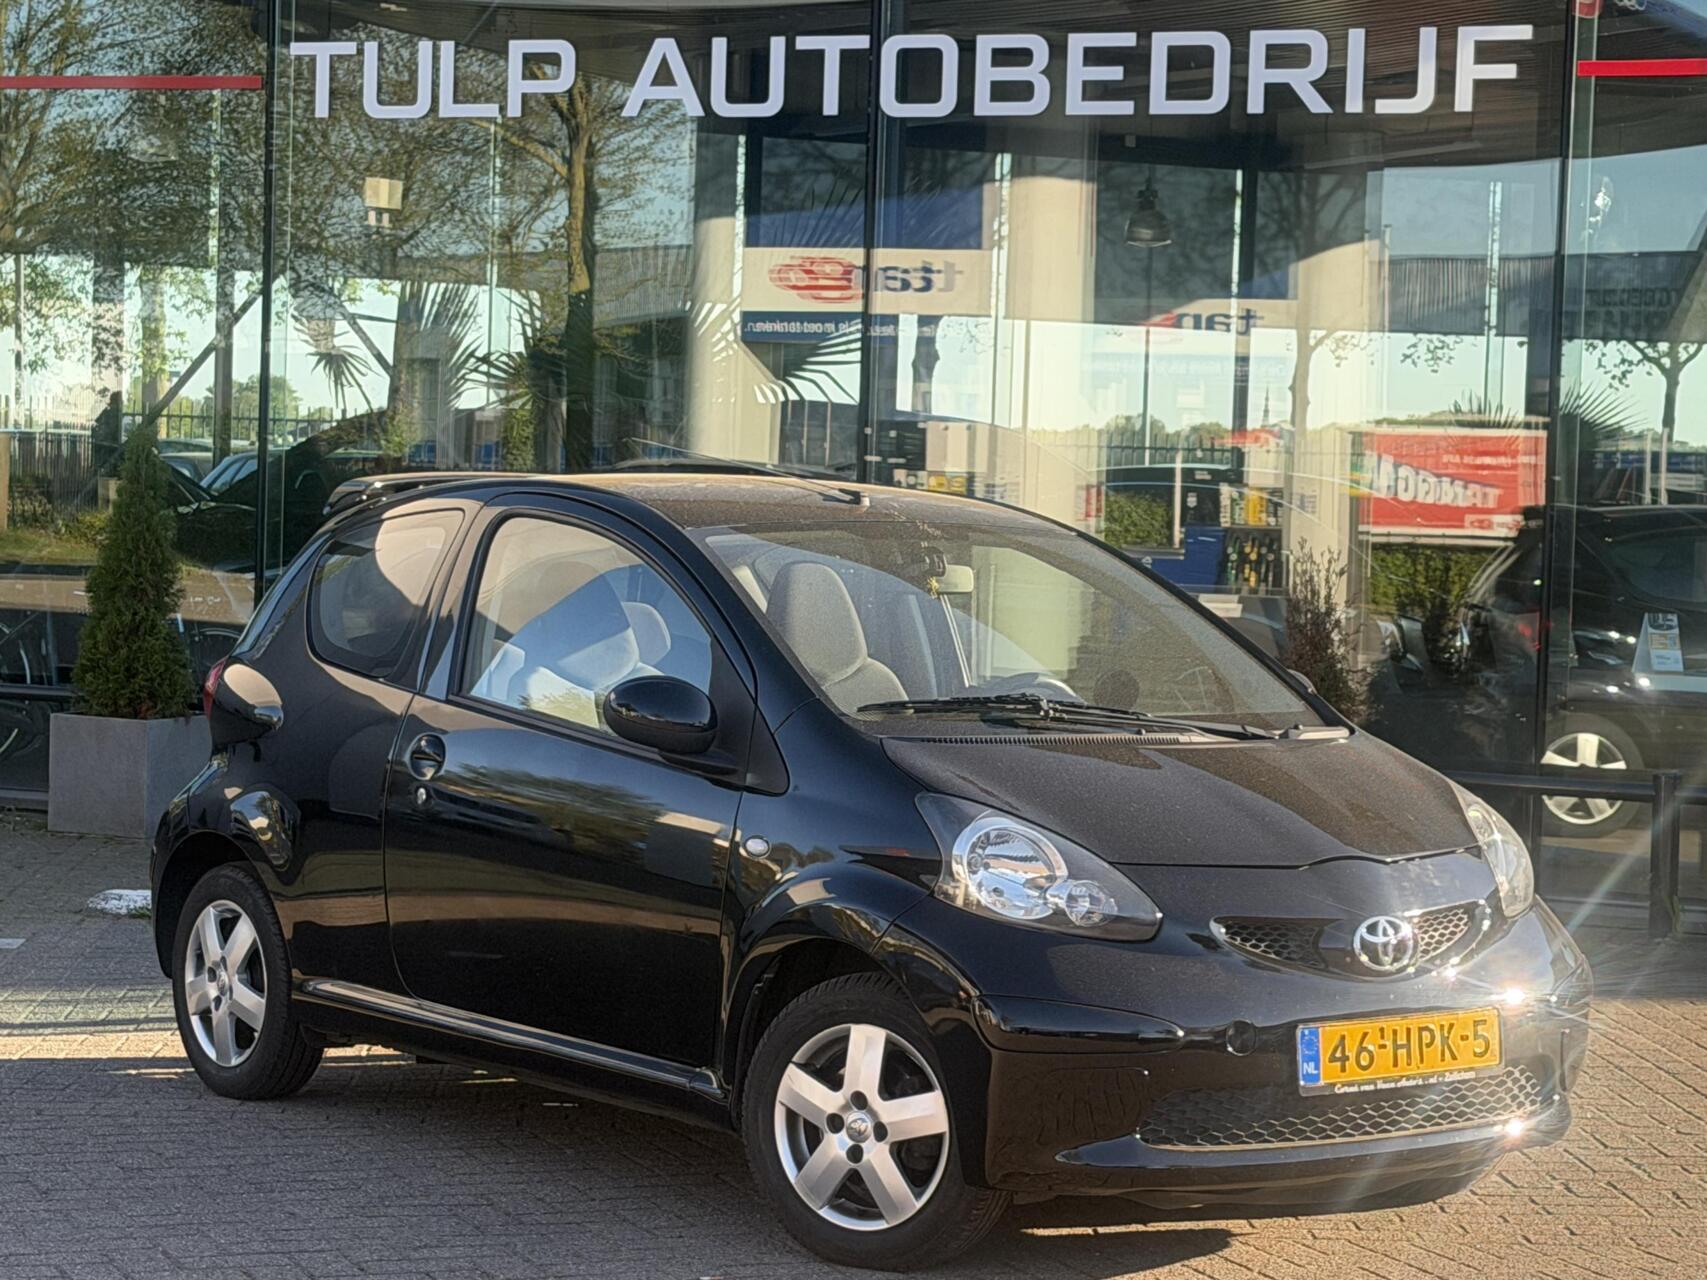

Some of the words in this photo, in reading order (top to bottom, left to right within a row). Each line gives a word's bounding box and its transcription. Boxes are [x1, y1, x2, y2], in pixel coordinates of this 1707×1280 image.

[290, 39, 576, 119] TULP
[622, 25, 1533, 119] AUTOBEDRIJF
[1303, 1061, 1319, 1075] NL
[1327, 1018, 1491, 1074] 46-HPK-5
